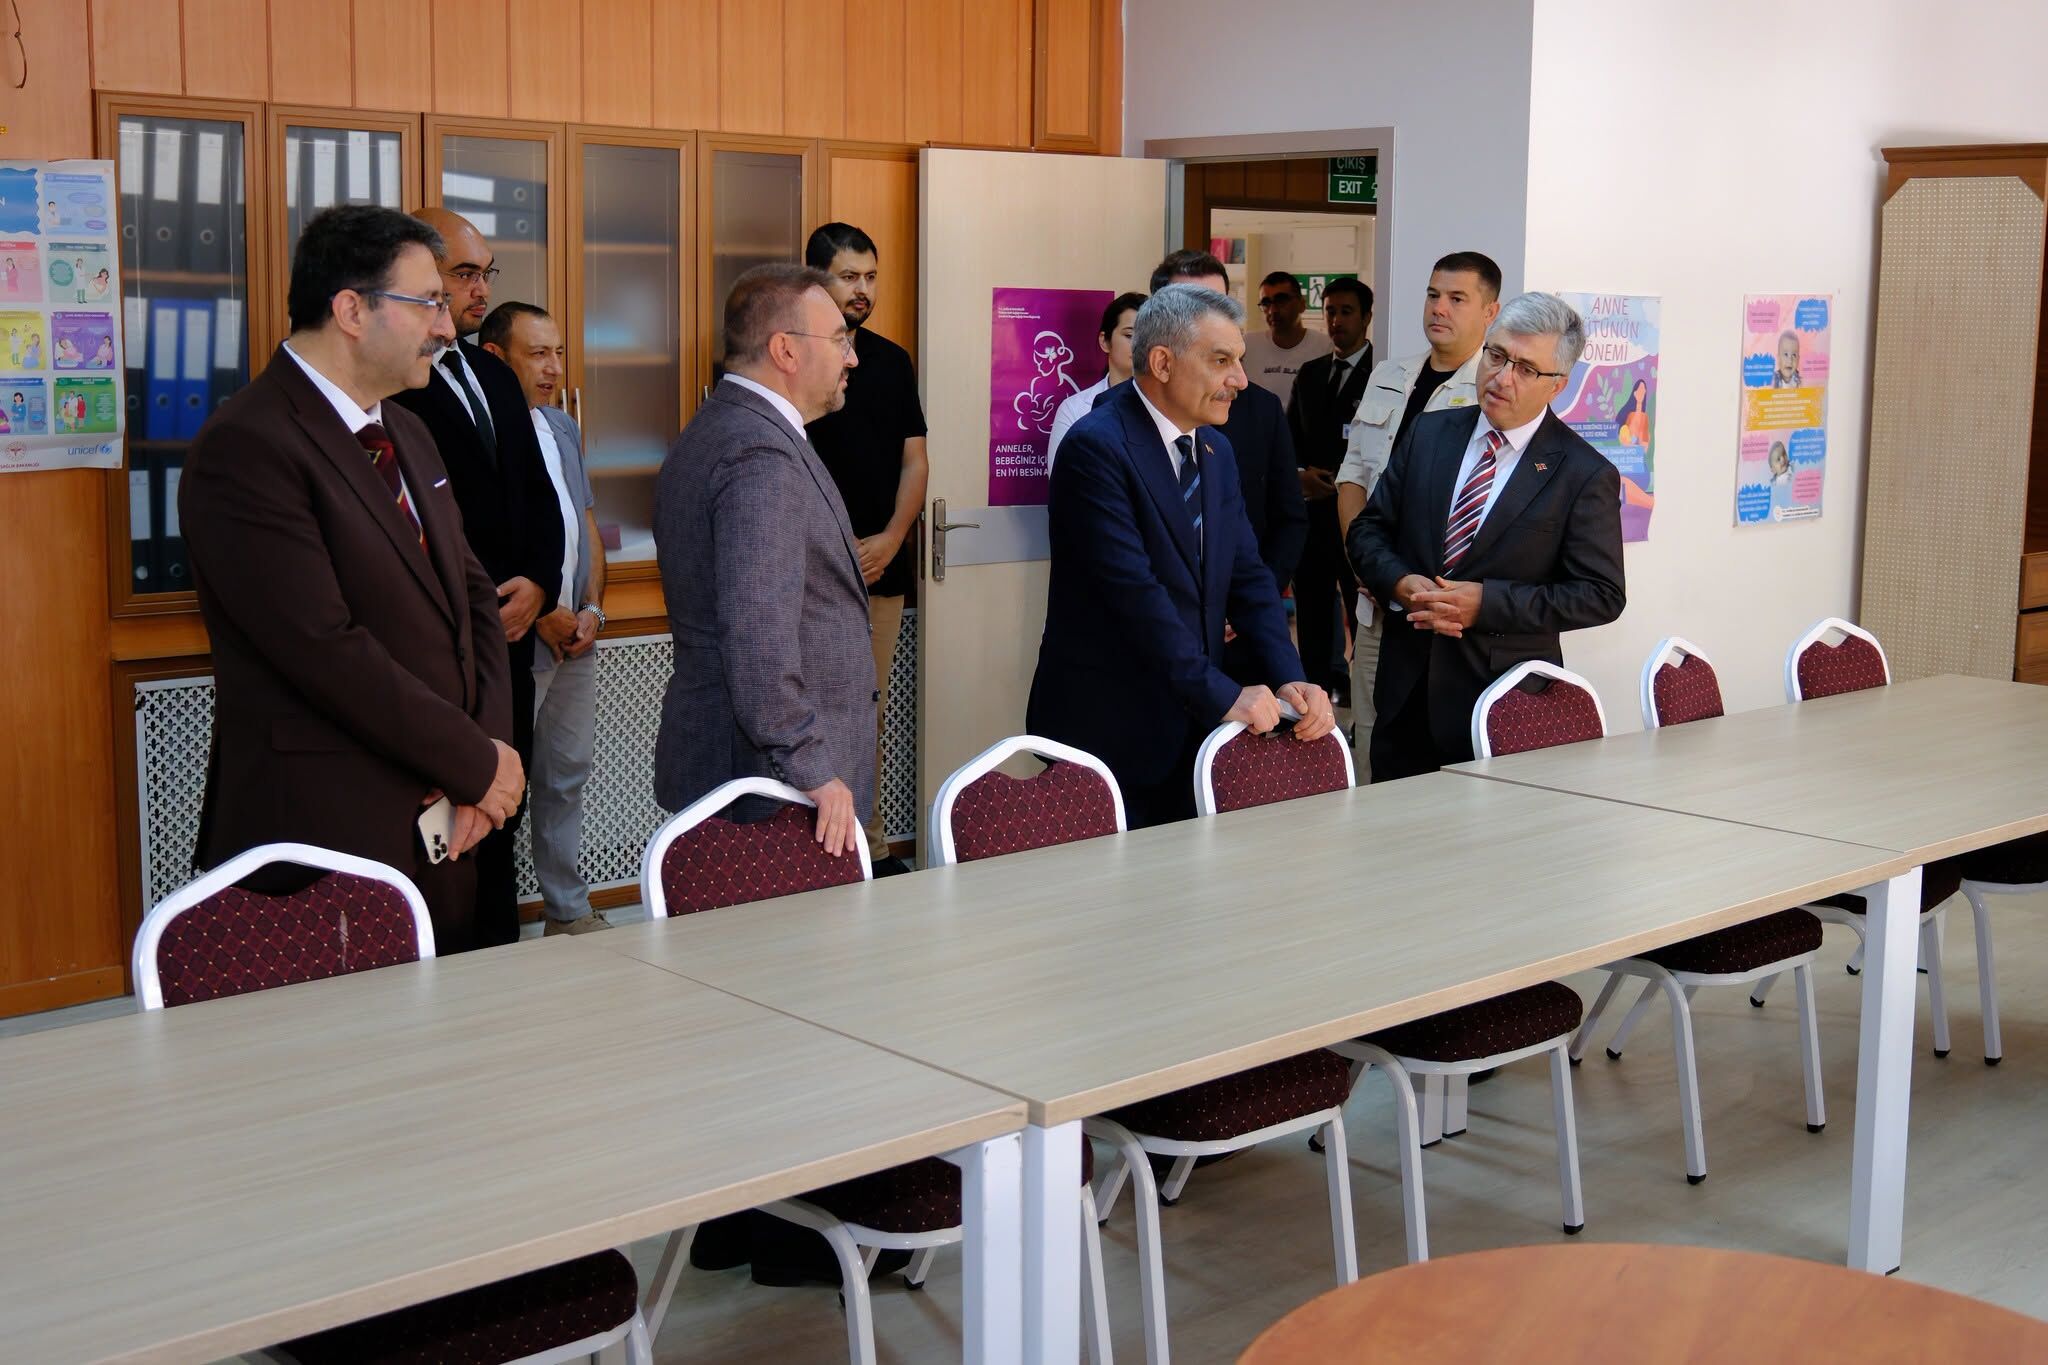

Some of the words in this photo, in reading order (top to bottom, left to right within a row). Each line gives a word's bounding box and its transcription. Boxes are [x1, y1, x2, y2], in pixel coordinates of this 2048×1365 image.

[1338, 180, 1363, 194] EXIT
[1591, 297, 1629, 315] ANNE
[1584, 317, 1639, 339] ÜTÜNÜN
[1583, 341, 1628, 361] ÖNEMİ
[68, 444, 98, 456] unicef
[995, 445, 1034, 453] ANNELER,
[995, 455, 1036, 465] BEBEĞİNİZ
[1037, 454, 1048, 466] İÇİ
[995, 469, 1006, 477] EN
[1008, 467, 1018, 477] İYİ
[1020, 467, 1042, 477] BESİN
